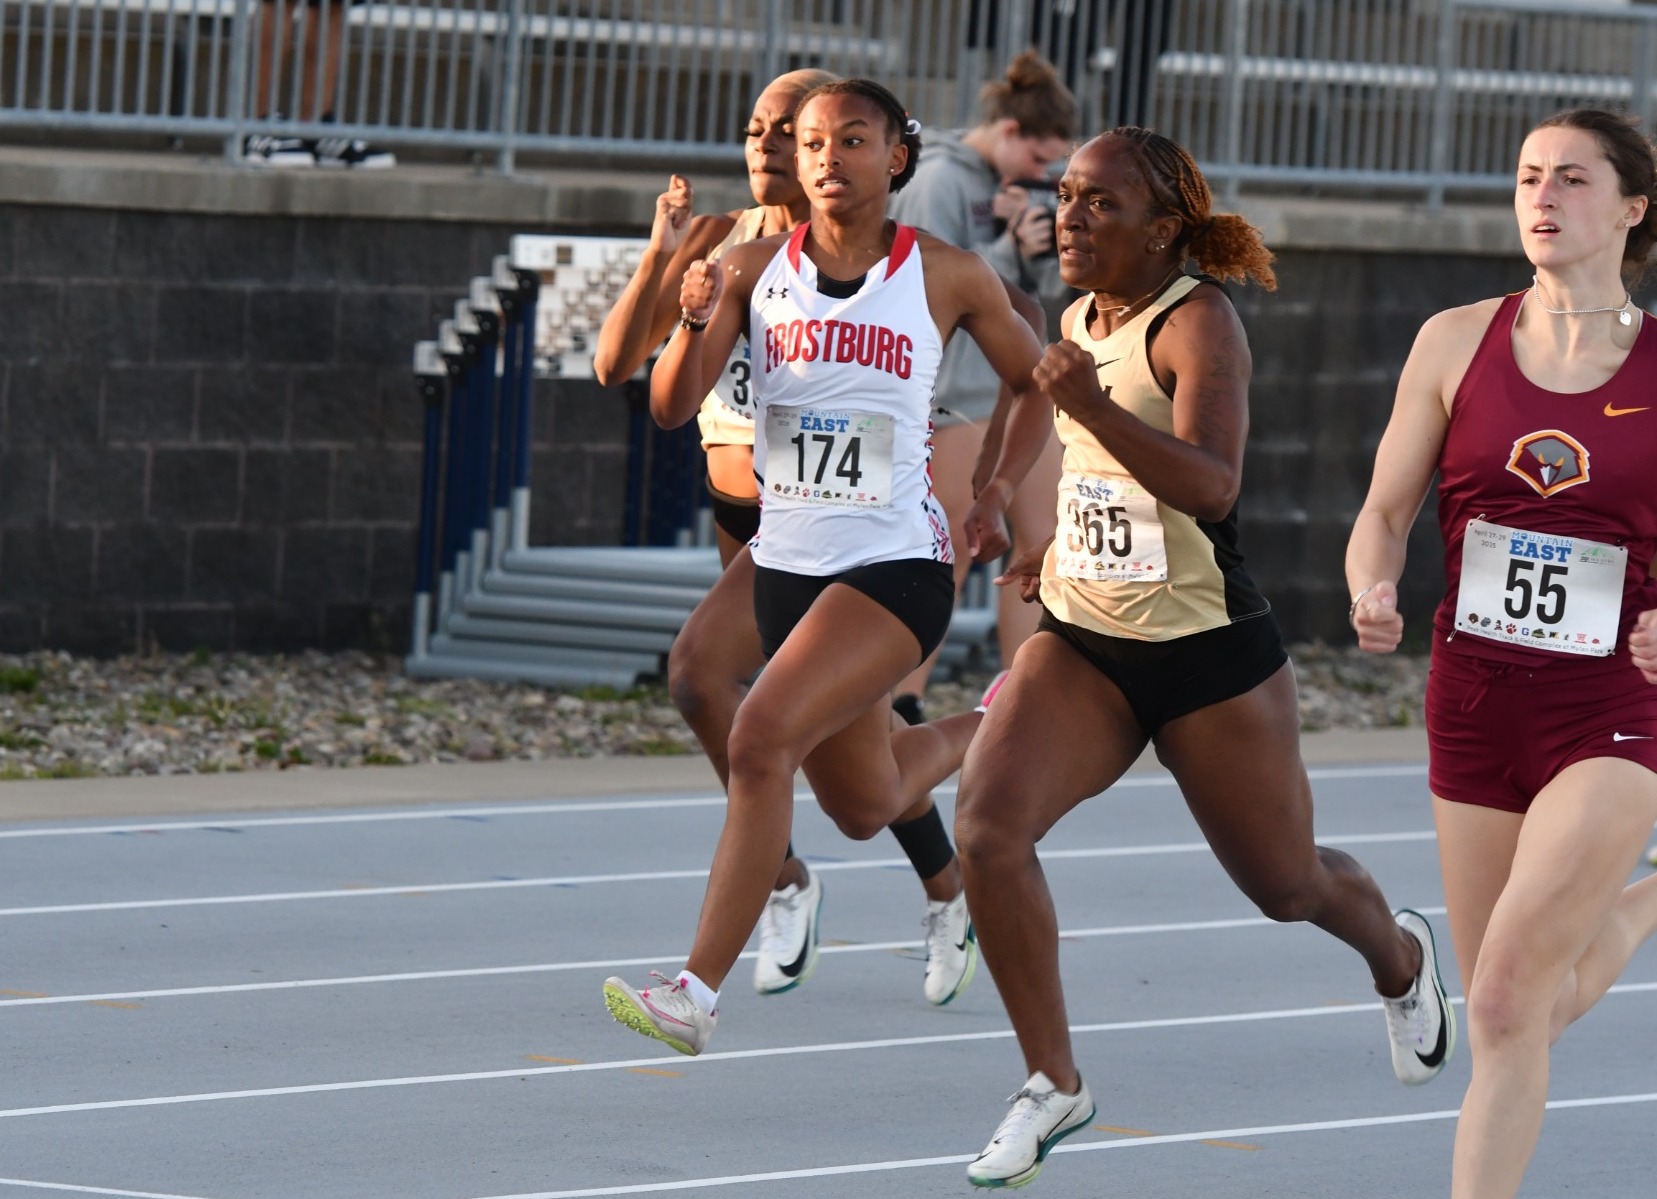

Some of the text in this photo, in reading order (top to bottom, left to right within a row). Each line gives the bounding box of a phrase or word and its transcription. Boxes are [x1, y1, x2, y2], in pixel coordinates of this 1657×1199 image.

[765, 319, 913, 379] FROSTBURG
[800, 416, 849, 433] EAST
[791, 432, 862, 487] 174
[1076, 483, 1113, 502] EAST
[1067, 498, 1132, 557] 365
[1511, 531, 1573, 547] MOUNTAIN
[1509, 539, 1572, 563] EAST
[1504, 558, 1568, 625] 55
[1535, 640, 1562, 649] Complex
